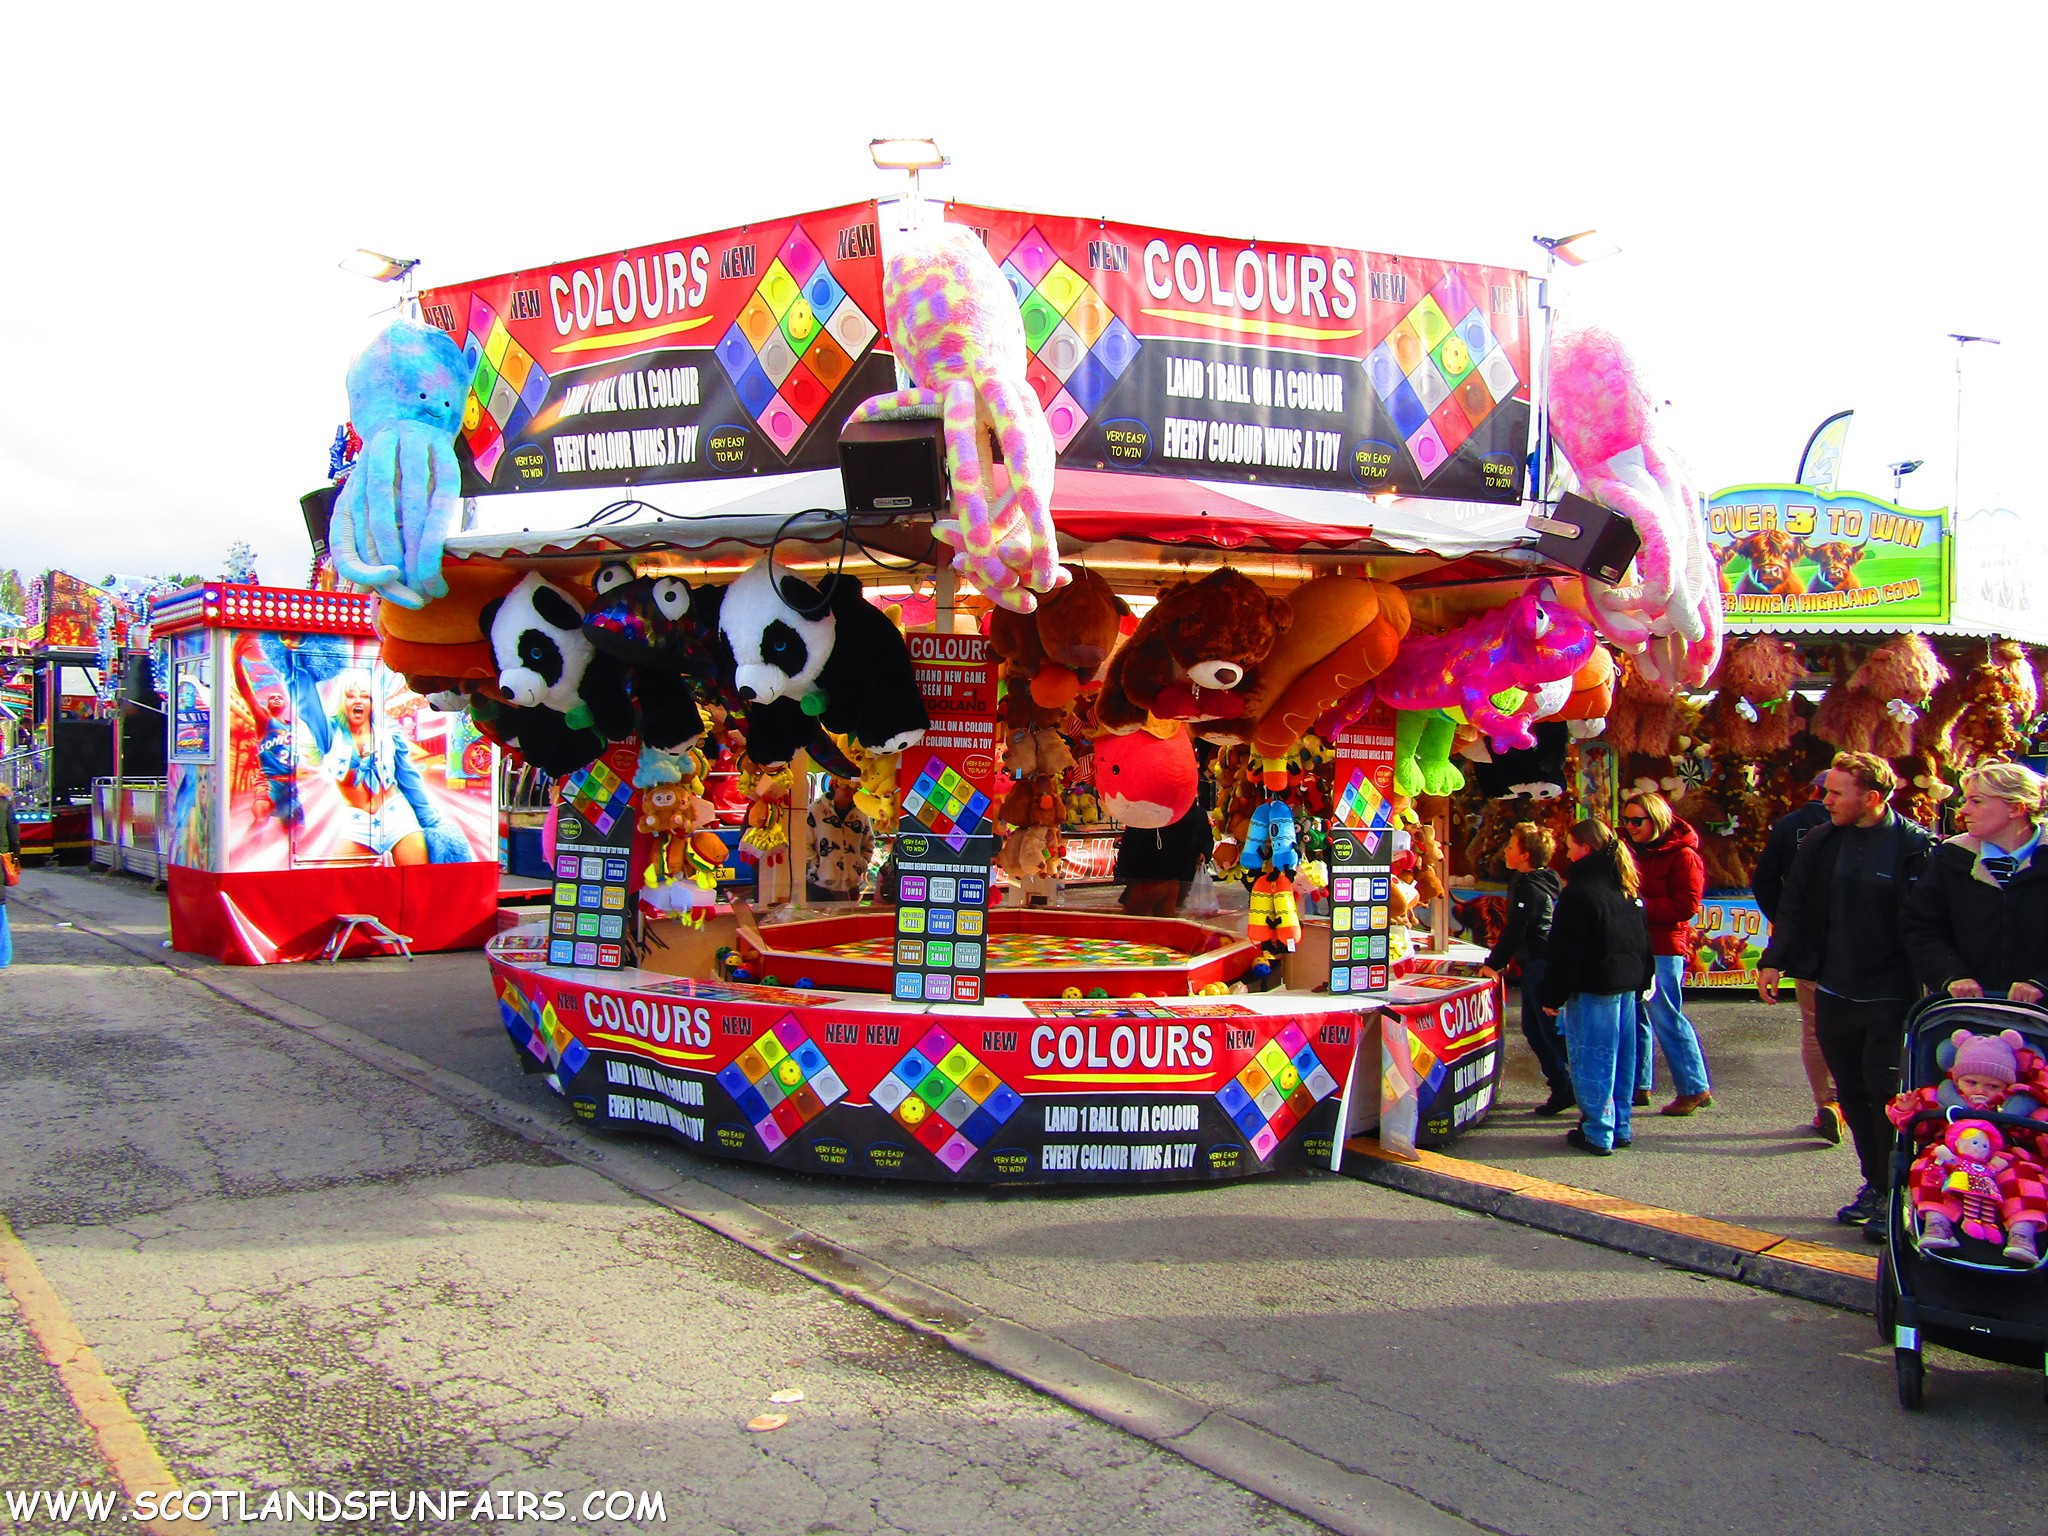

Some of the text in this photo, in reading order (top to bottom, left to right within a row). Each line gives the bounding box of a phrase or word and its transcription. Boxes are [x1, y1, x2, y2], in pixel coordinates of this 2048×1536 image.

[835, 222, 877, 260] NEW
[720, 244, 757, 279] NEW
[1087, 240, 1129, 273] NEW
[1142, 238, 1357, 320] COLOURS
[549, 244, 711, 337] COLOURS
[1369, 271, 1406, 304] NEW
[510, 288, 542, 321] NEW
[1490, 286, 1525, 317] NEW
[590, 376, 618, 413] BALL
[618, 372, 637, 411] ON
[637, 371, 649, 409] A
[648, 366, 700, 408] COLOUR
[1166, 356, 1343, 412] LAND 1 BALL ON A COLOUR
[710, 436, 745, 449] VERY EASY
[1105, 430, 1147, 444] VERY EASY
[553, 425, 700, 473] EVERY COLOUR WINS A TOY
[1111, 445, 1142, 458] TO WIN
[1163, 417, 1342, 472] EVERY COLOUR WINS A TOY
[514, 454, 544, 467] VERY EASY
[716, 450, 744, 463] TO PLAY
[1355, 451, 1391, 464] VERY EASY
[521, 467, 543, 478] TO WIN
[1360, 465, 1388, 478] TO PLAY
[1482, 463, 1514, 475] VERY EASY
[1485, 476, 1511, 488] TO WIN
[1709, 504, 1925, 549] OVER 3 TO WIN
[1740, 594, 1782, 613] WINS
[1786, 594, 1797, 613] A
[1800, 586, 1879, 612] HIGHLAND
[1882, 579, 1920, 605] COW
[915, 669, 986, 684] BRAND NEW GAME
[922, 684, 941, 696] SEEN
[944, 685, 952, 697] IN
[922, 696, 987, 712] GOLAND
[947, 721, 958, 732] ON
[958, 721, 964, 732] A
[964, 721, 993, 733] COLOUR
[926, 736, 953, 748] COLOUR
[953, 737, 973, 749] WINS
[973, 738, 979, 749] A
[979, 738, 993, 749] TOY
[905, 888, 922, 896] JUMBO
[963, 891, 980, 899] JUMBO
[904, 920, 920, 928] SMALL
[932, 921, 950, 929] JUMBO
[961, 922, 978, 930] SMALL
[1729, 907, 1761, 935] TO
[902, 952, 919, 960] JUMBO
[931, 953, 948, 961] SMALL
[1696, 972, 1705, 986] A
[1708, 970, 1759, 986] HIGHLA
[901, 985, 917, 993] SMALL
[929, 987, 947, 995] JUMBO
[958, 988, 975, 996] SMALL
[557, 992, 578, 1011] NEW
[584, 991, 711, 1048] COLOURS
[1439, 987, 1495, 1038] COLOURS
[722, 1016, 752, 1036] NEW
[1416, 1013, 1435, 1031] NEW
[824, 1023, 859, 1045] NEW
[866, 1025, 900, 1045] NEW
[1225, 1029, 1256, 1050] NEW
[1319, 1025, 1351, 1045] NEW
[982, 1031, 1017, 1052] NEW
[1029, 1024, 1214, 1069] COLOURS
[608, 1094, 635, 1119] EVERY
[1044, 1104, 1199, 1132] LAND 1 BALL ON A COLOUR
[717, 1129, 745, 1139] VERY EASY
[721, 1138, 729, 1146] TO
[814, 1145, 847, 1155] VERY EASY
[870, 1150, 905, 1159] VERY EASY
[1042, 1143, 1197, 1170] EVERY COLOUR WINS A TOY
[1208, 1151, 1239, 1160] VERY EASY
[820, 1154, 845, 1163] TO WIN
[875, 1159, 902, 1168] TO PLAY
[993, 1155, 1027, 1164] VERY EASY
[1213, 1160, 1236, 1168] TO PLAY
[998, 1165, 1025, 1173] TO WIN
